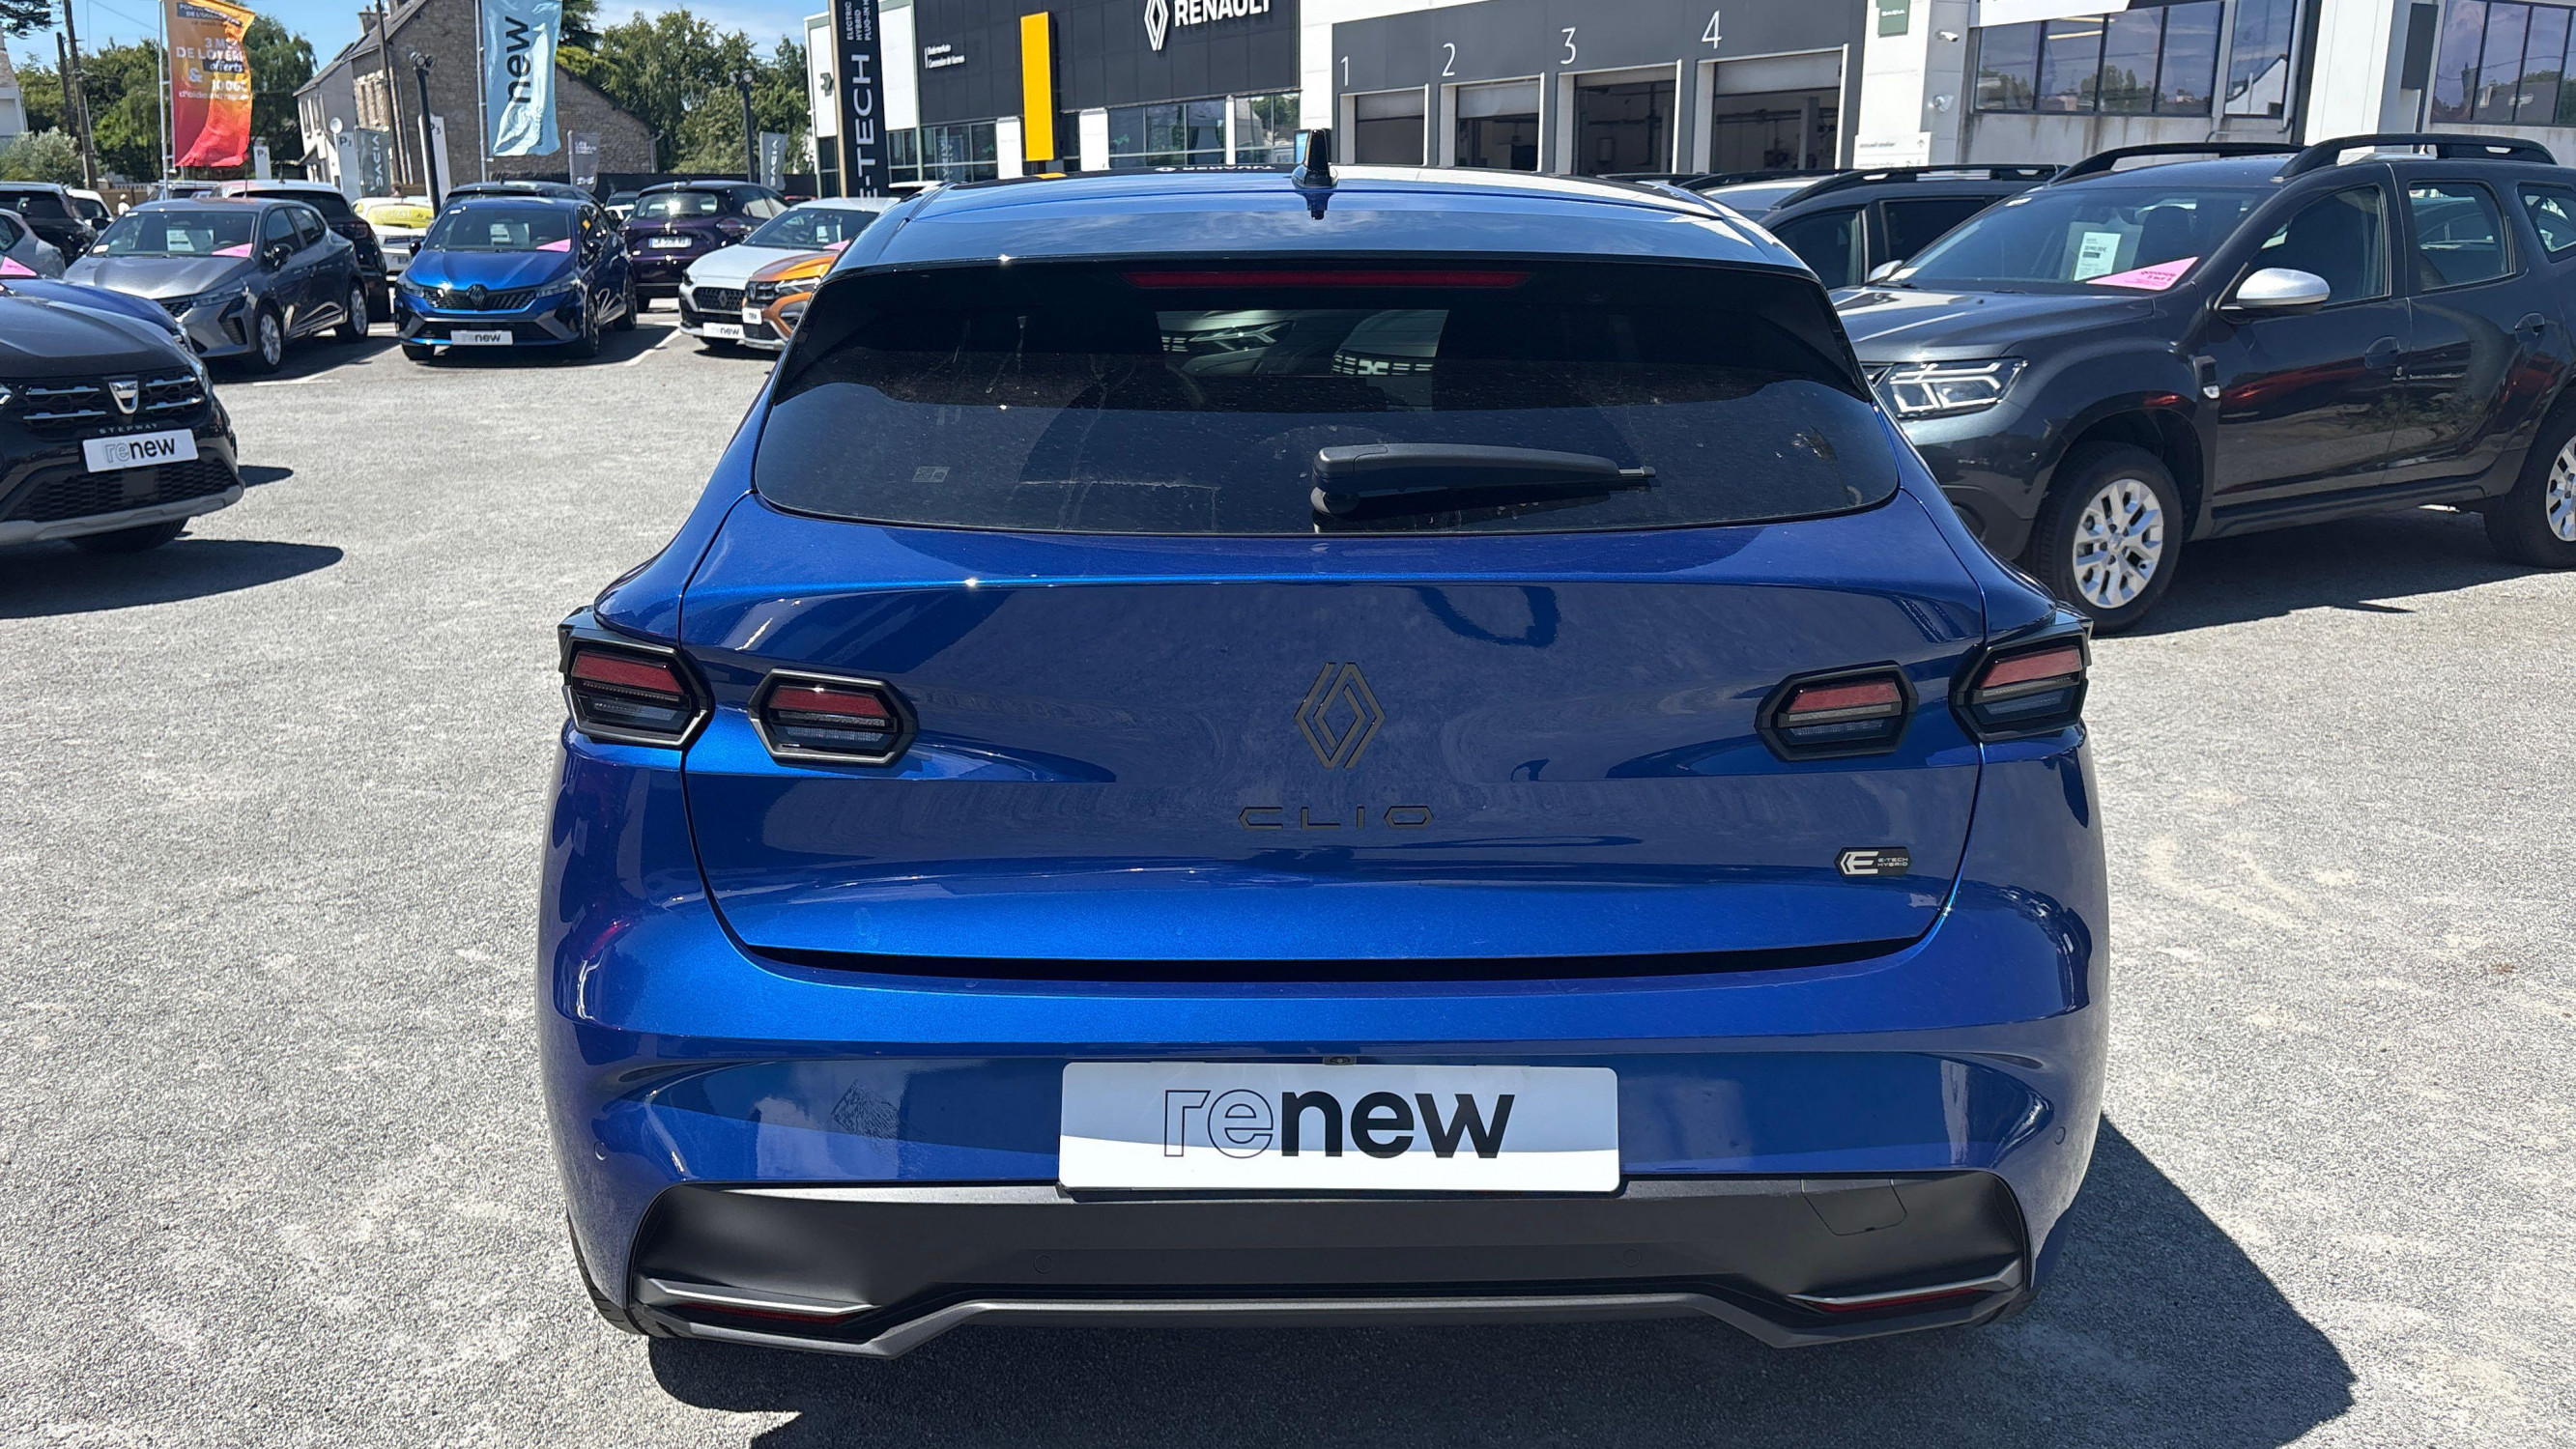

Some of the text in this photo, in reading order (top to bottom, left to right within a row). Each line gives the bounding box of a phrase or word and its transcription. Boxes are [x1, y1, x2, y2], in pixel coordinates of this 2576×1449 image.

[844, 1, 854, 41] ELECTRIC
[854, 10, 863, 41] HYBRID
[863, 7, 872, 41] PLUG-IN
[1702, 10, 1723, 50] 4
[176, 46, 193, 59] DE
[1442, 43, 1456, 77] 2
[1560, 27, 1577, 65] 3
[209, 59, 243, 72] offerts
[1340, 56, 1349, 87] 1
[99, 423, 157, 435] STEPWAY
[104, 437, 176, 464] renew
[1239, 805, 1435, 831] CLIO
[1163, 1089, 1515, 1159] renew
